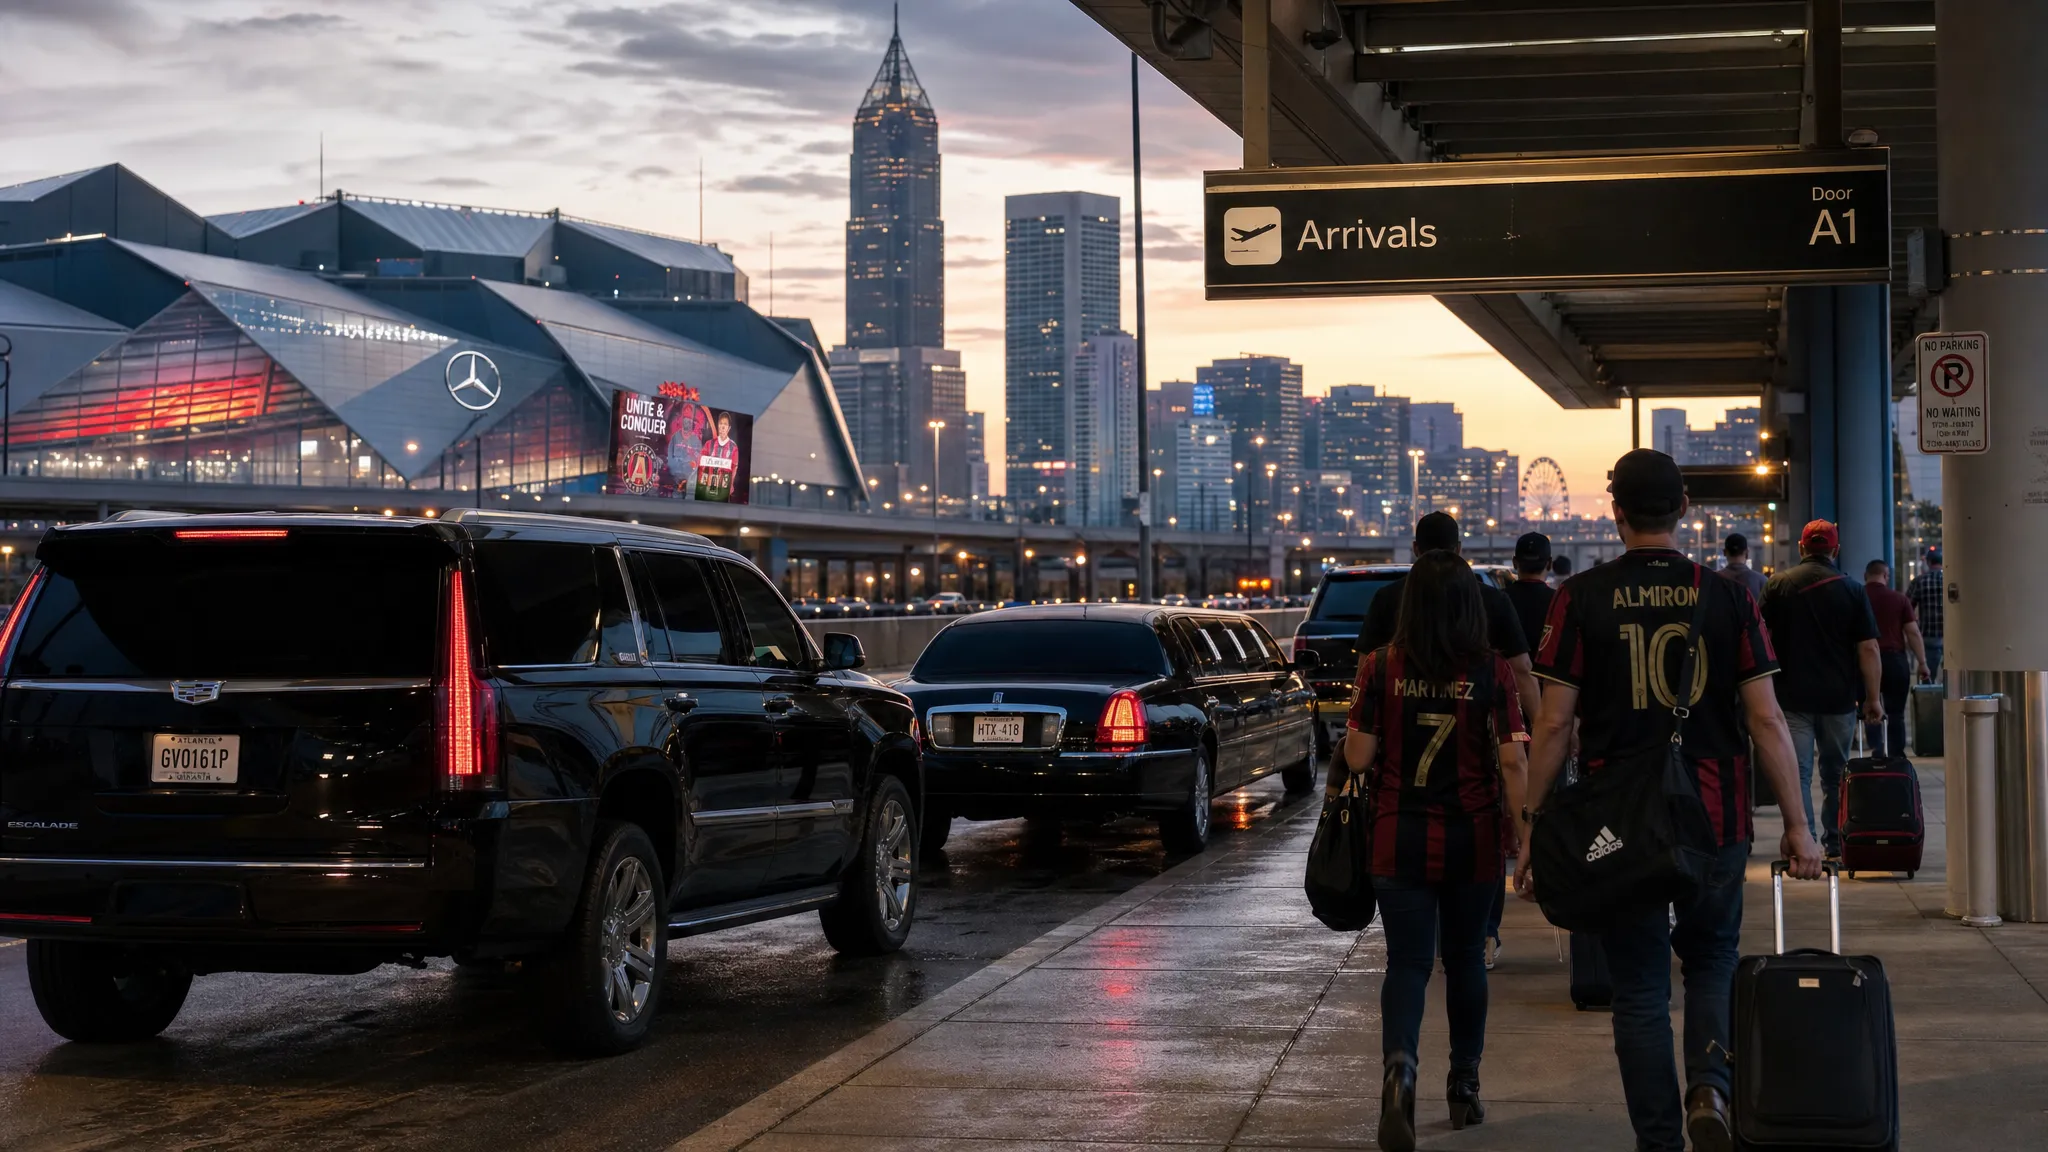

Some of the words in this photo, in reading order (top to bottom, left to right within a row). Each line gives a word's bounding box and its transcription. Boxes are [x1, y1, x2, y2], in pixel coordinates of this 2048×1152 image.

[1812, 186, 1853, 201] Door
[1296, 216, 1438, 251] Arrivals
[1808, 208, 1856, 245] A1
[1924, 341, 1937, 351] NO
[1940, 339, 1979, 351] PARKING
[626, 397, 655, 418] UNITE
[656, 403, 665, 418] &
[1926, 407, 1939, 418] NO
[1942, 406, 1981, 418] WAITING
[620, 413, 667, 435] CONQUER
[1612, 585, 1700, 609] ALMIRON
[1619, 621, 1709, 710] 10
[161, 747, 229, 769] GV0161P
[1414, 712, 1457, 787] 7
[7, 821, 79, 829] ESCALADE
[1586, 839, 1624, 862] adidas
